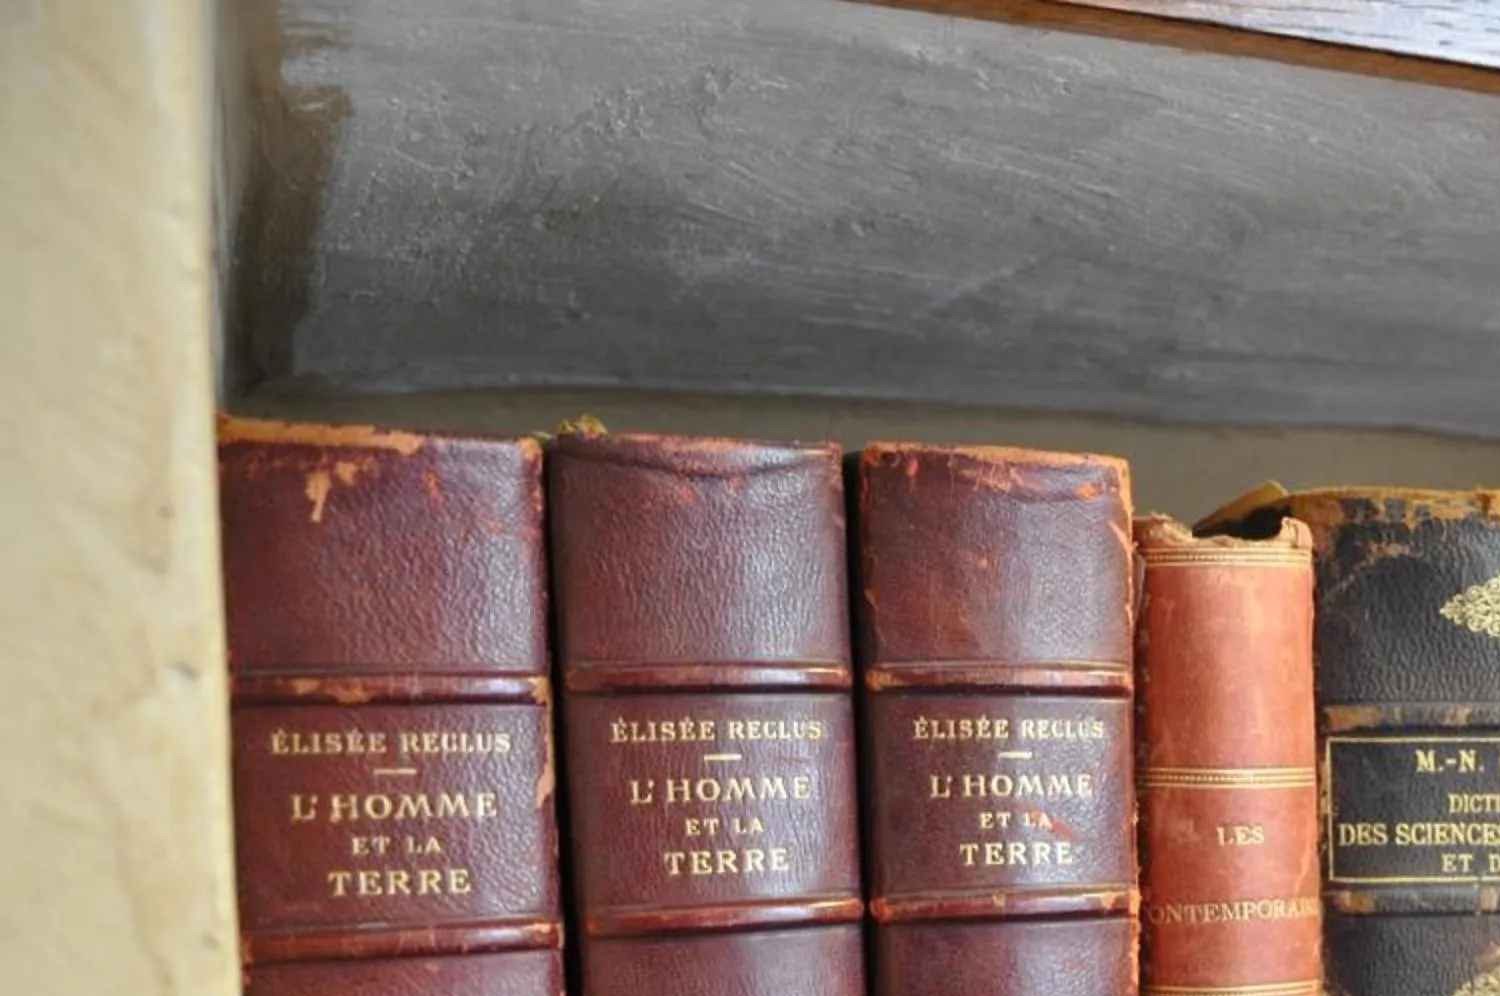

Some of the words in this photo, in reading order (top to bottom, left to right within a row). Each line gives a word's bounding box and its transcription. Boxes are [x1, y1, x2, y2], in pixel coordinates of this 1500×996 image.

[611, 716, 716, 743] ÉLISÉE
[728, 719, 823, 741] RECLUS
[913, 715, 1010, 740] ÉLISÉE
[1020, 719, 1104, 740] RECLUS
[270, 729, 387, 754] ÉLISÉE
[400, 731, 512, 754] RECLUS
[684, 818, 719, 836] ET
[735, 817, 765, 834] LA
[979, 812, 1011, 829] ET
[1025, 811, 1052, 828] LA
[351, 835, 391, 855] ET
[406, 835, 442, 854] LA
[1216, 825, 1264, 846] LES
[1338, 822, 1388, 847] DES
[664, 849, 790, 876] TERRE
[959, 841, 1075, 867] TERRE
[1441, 853, 1473, 874] ET
[328, 868, 473, 897] TERRE
